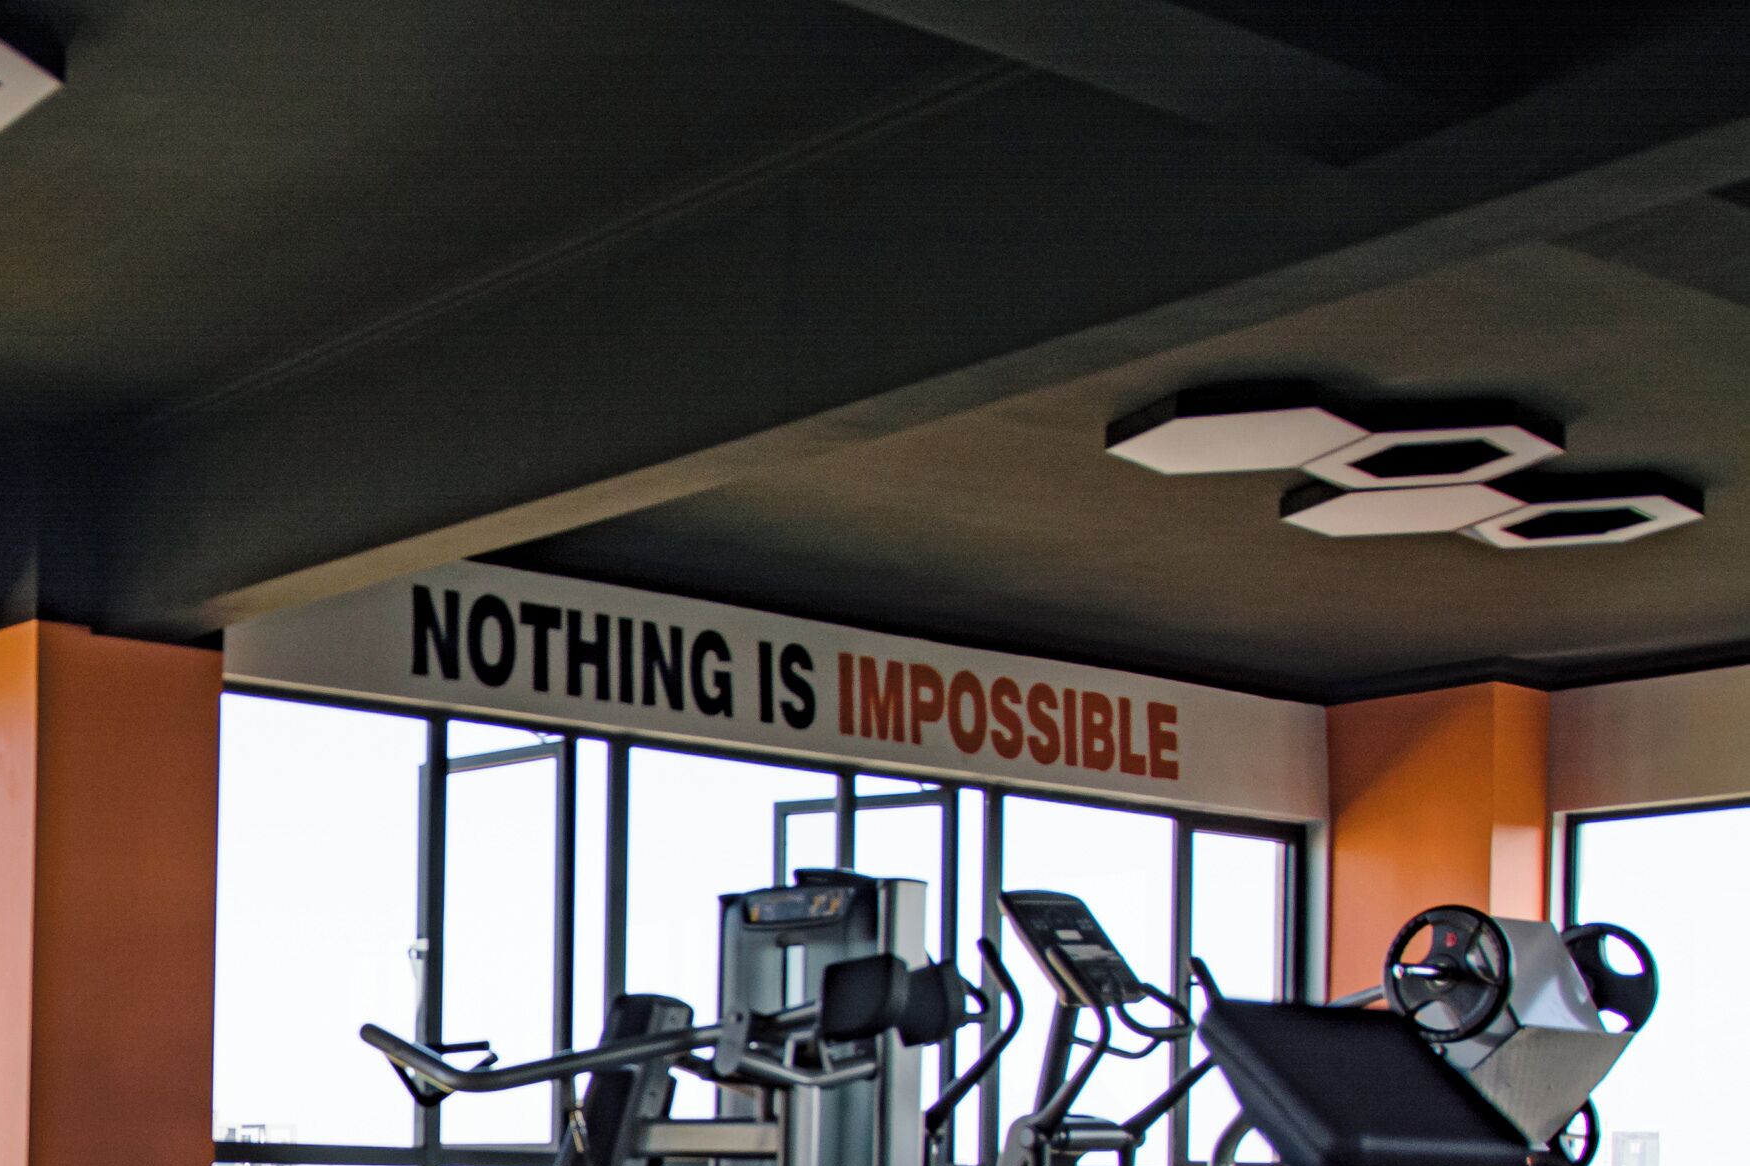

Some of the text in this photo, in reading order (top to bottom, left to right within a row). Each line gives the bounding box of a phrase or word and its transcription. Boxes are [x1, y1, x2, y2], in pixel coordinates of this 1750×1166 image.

[411, 584, 1179, 781] NOTHING IS IMPOSSIBLE
